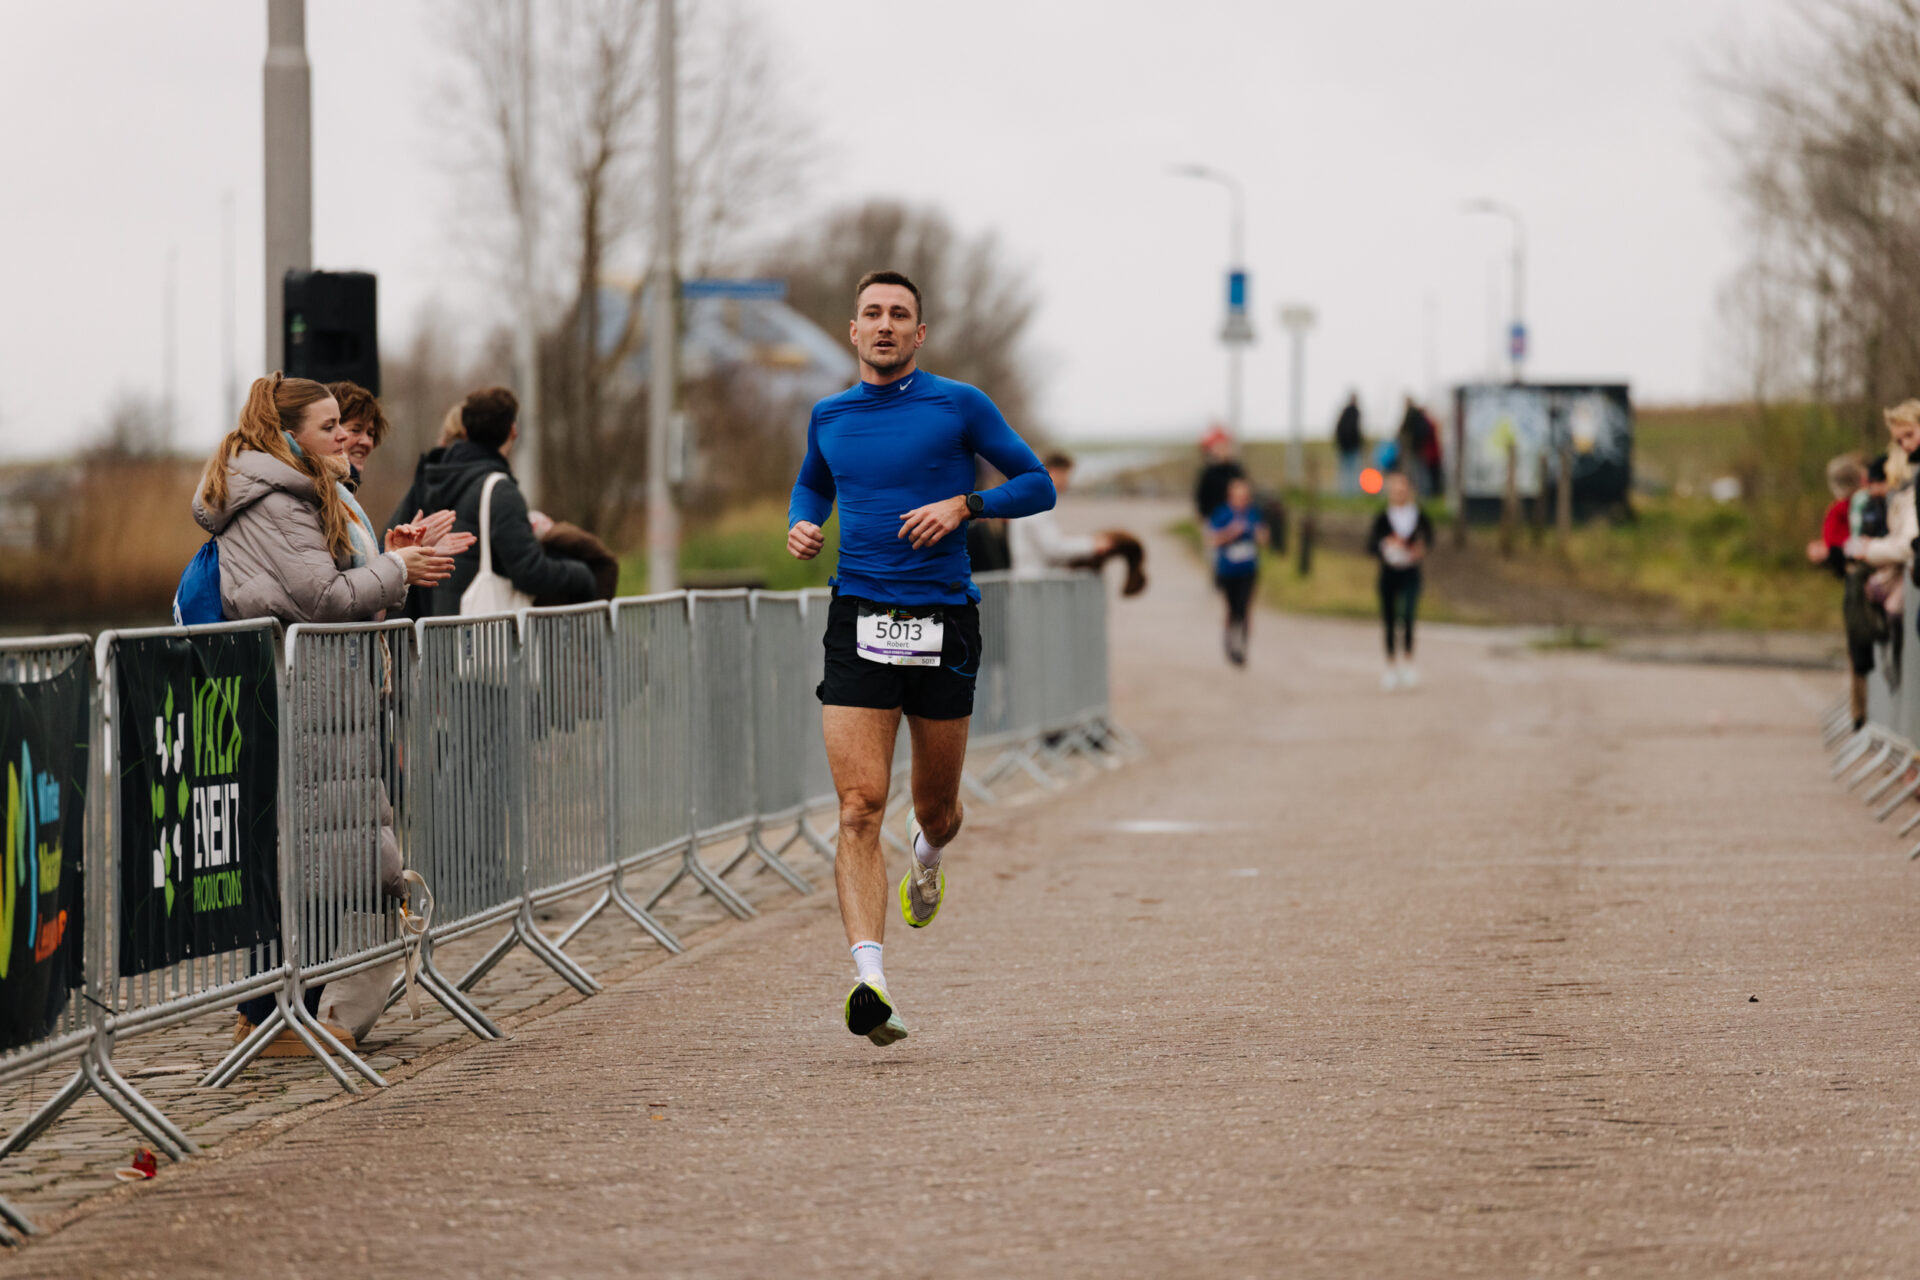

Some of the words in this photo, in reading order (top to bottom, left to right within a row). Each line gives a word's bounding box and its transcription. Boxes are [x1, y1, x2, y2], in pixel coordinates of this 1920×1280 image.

[876, 621, 922, 641] 5013
[192, 675, 242, 777] VALK
[193, 783, 240, 870] EVENT
[193, 869, 242, 913] PRODUCTIONS
